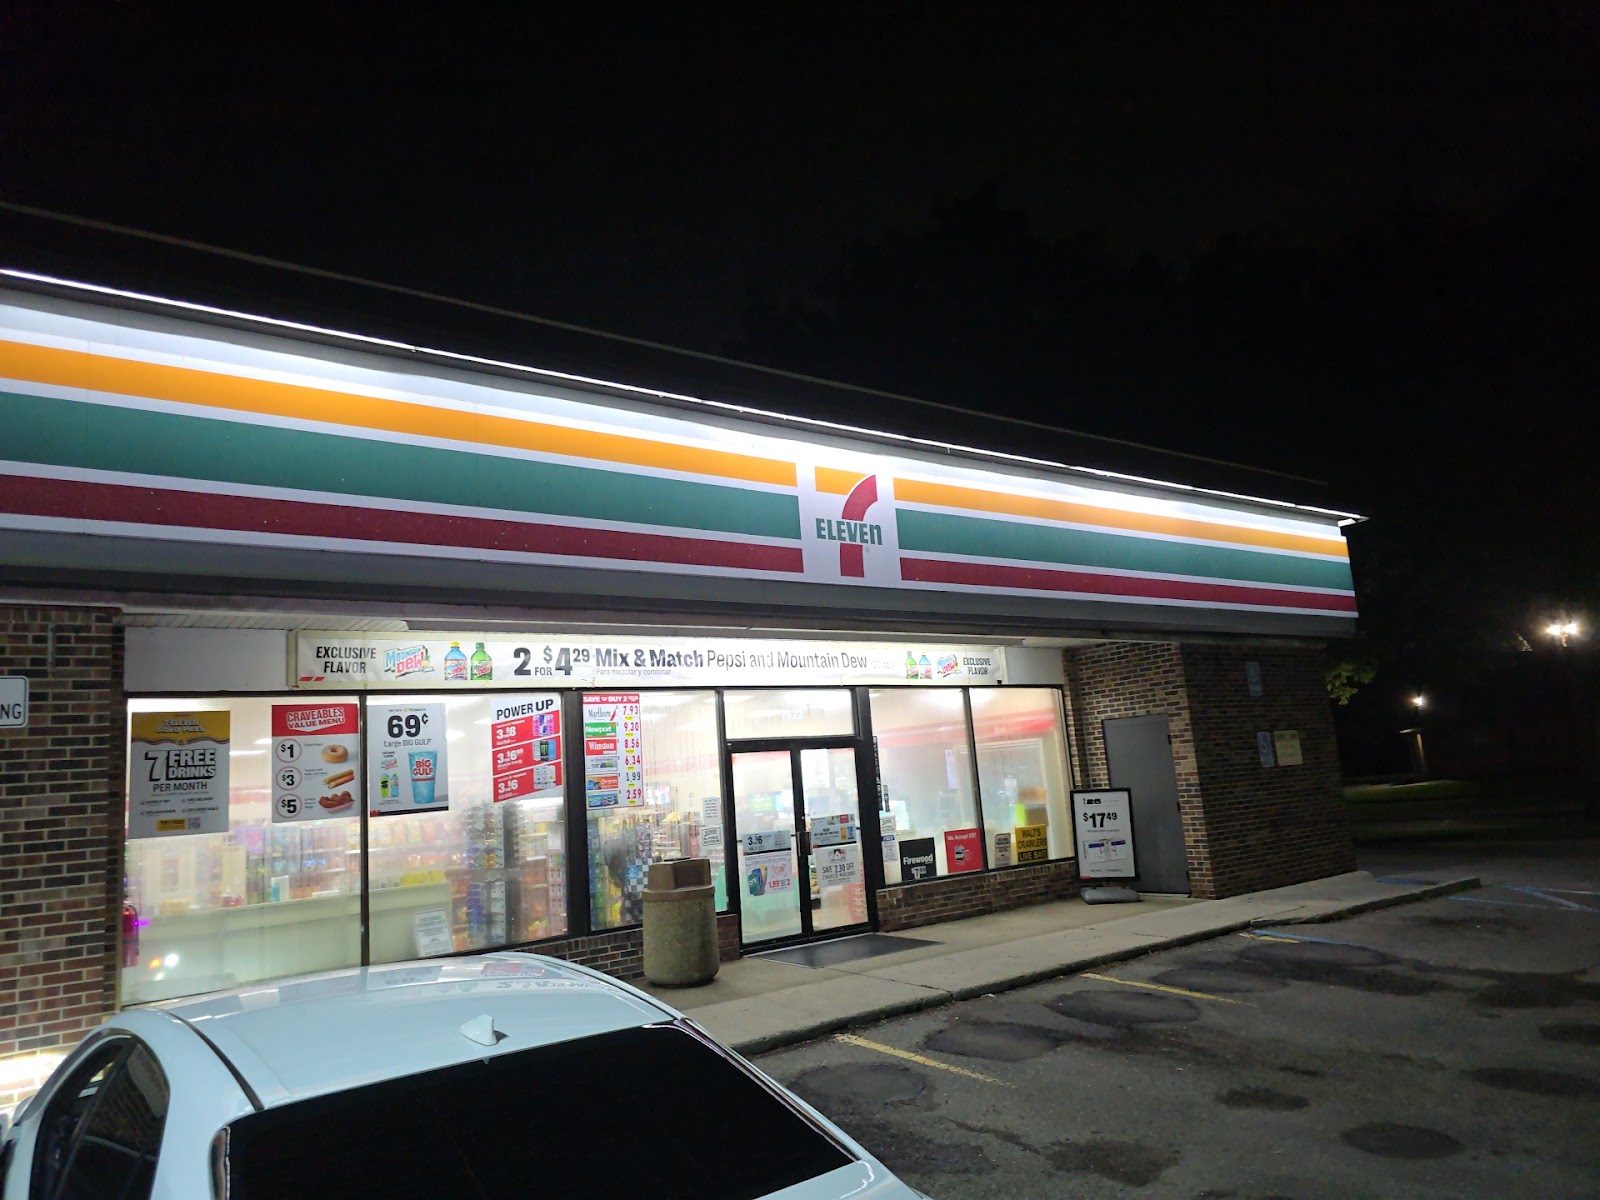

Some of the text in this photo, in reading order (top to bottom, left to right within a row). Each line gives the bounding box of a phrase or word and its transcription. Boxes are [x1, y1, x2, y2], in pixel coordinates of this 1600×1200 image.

[840, 474, 878, 578] 7
[316, 646, 377, 659] EXCLUSIVE
[324, 661, 366, 673] FLAVOR
[513, 647, 531, 676] 2
[534, 667, 552, 676] FOR
[595, 648, 629, 667] Mix
[634, 648, 646, 667] &
[649, 649, 704, 668] Match
[707, 650, 746, 671] Pepsi
[750, 651, 773, 668] and
[777, 651, 839, 668] Mountain
[841, 652, 867, 668] Dew
[963, 657, 991, 666] EXCLUSIVE
[596, 668, 671, 677] Para mezclar y combinar
[968, 667, 988, 675] FLAVOR
[287, 707, 344, 723] CRAVEABLES
[496, 698, 554, 720] POWER UP
[588, 706, 612, 718] Marlboro
[623, 705, 639, 716] 7.93
[288, 717, 344, 729] VALUE MENU
[585, 722, 639, 734] Newport 9.30
[496, 729, 504, 740] 3
[384, 740, 402, 748] Large
[402, 739, 413, 747] BIG
[588, 738, 640, 750] Winston 8.56
[280, 743, 294, 758] $1
[497, 753, 505, 764] 3
[625, 755, 641, 766] 6.34
[144, 748, 216, 782] 7 FREE
[166, 765, 216, 781] DRINKS
[413, 767, 434, 776] GULP
[281, 774, 295, 786] $3
[153, 782, 207, 792] PER MONTH
[498, 782, 506, 793] 3
[626, 788, 642, 800] 2.59
[281, 798, 297, 814] $5
[747, 836, 753, 846] 3
[903, 853, 934, 866] Firewood
[821, 865, 833, 874] SAVE
[834, 863, 846, 873] 2.30
